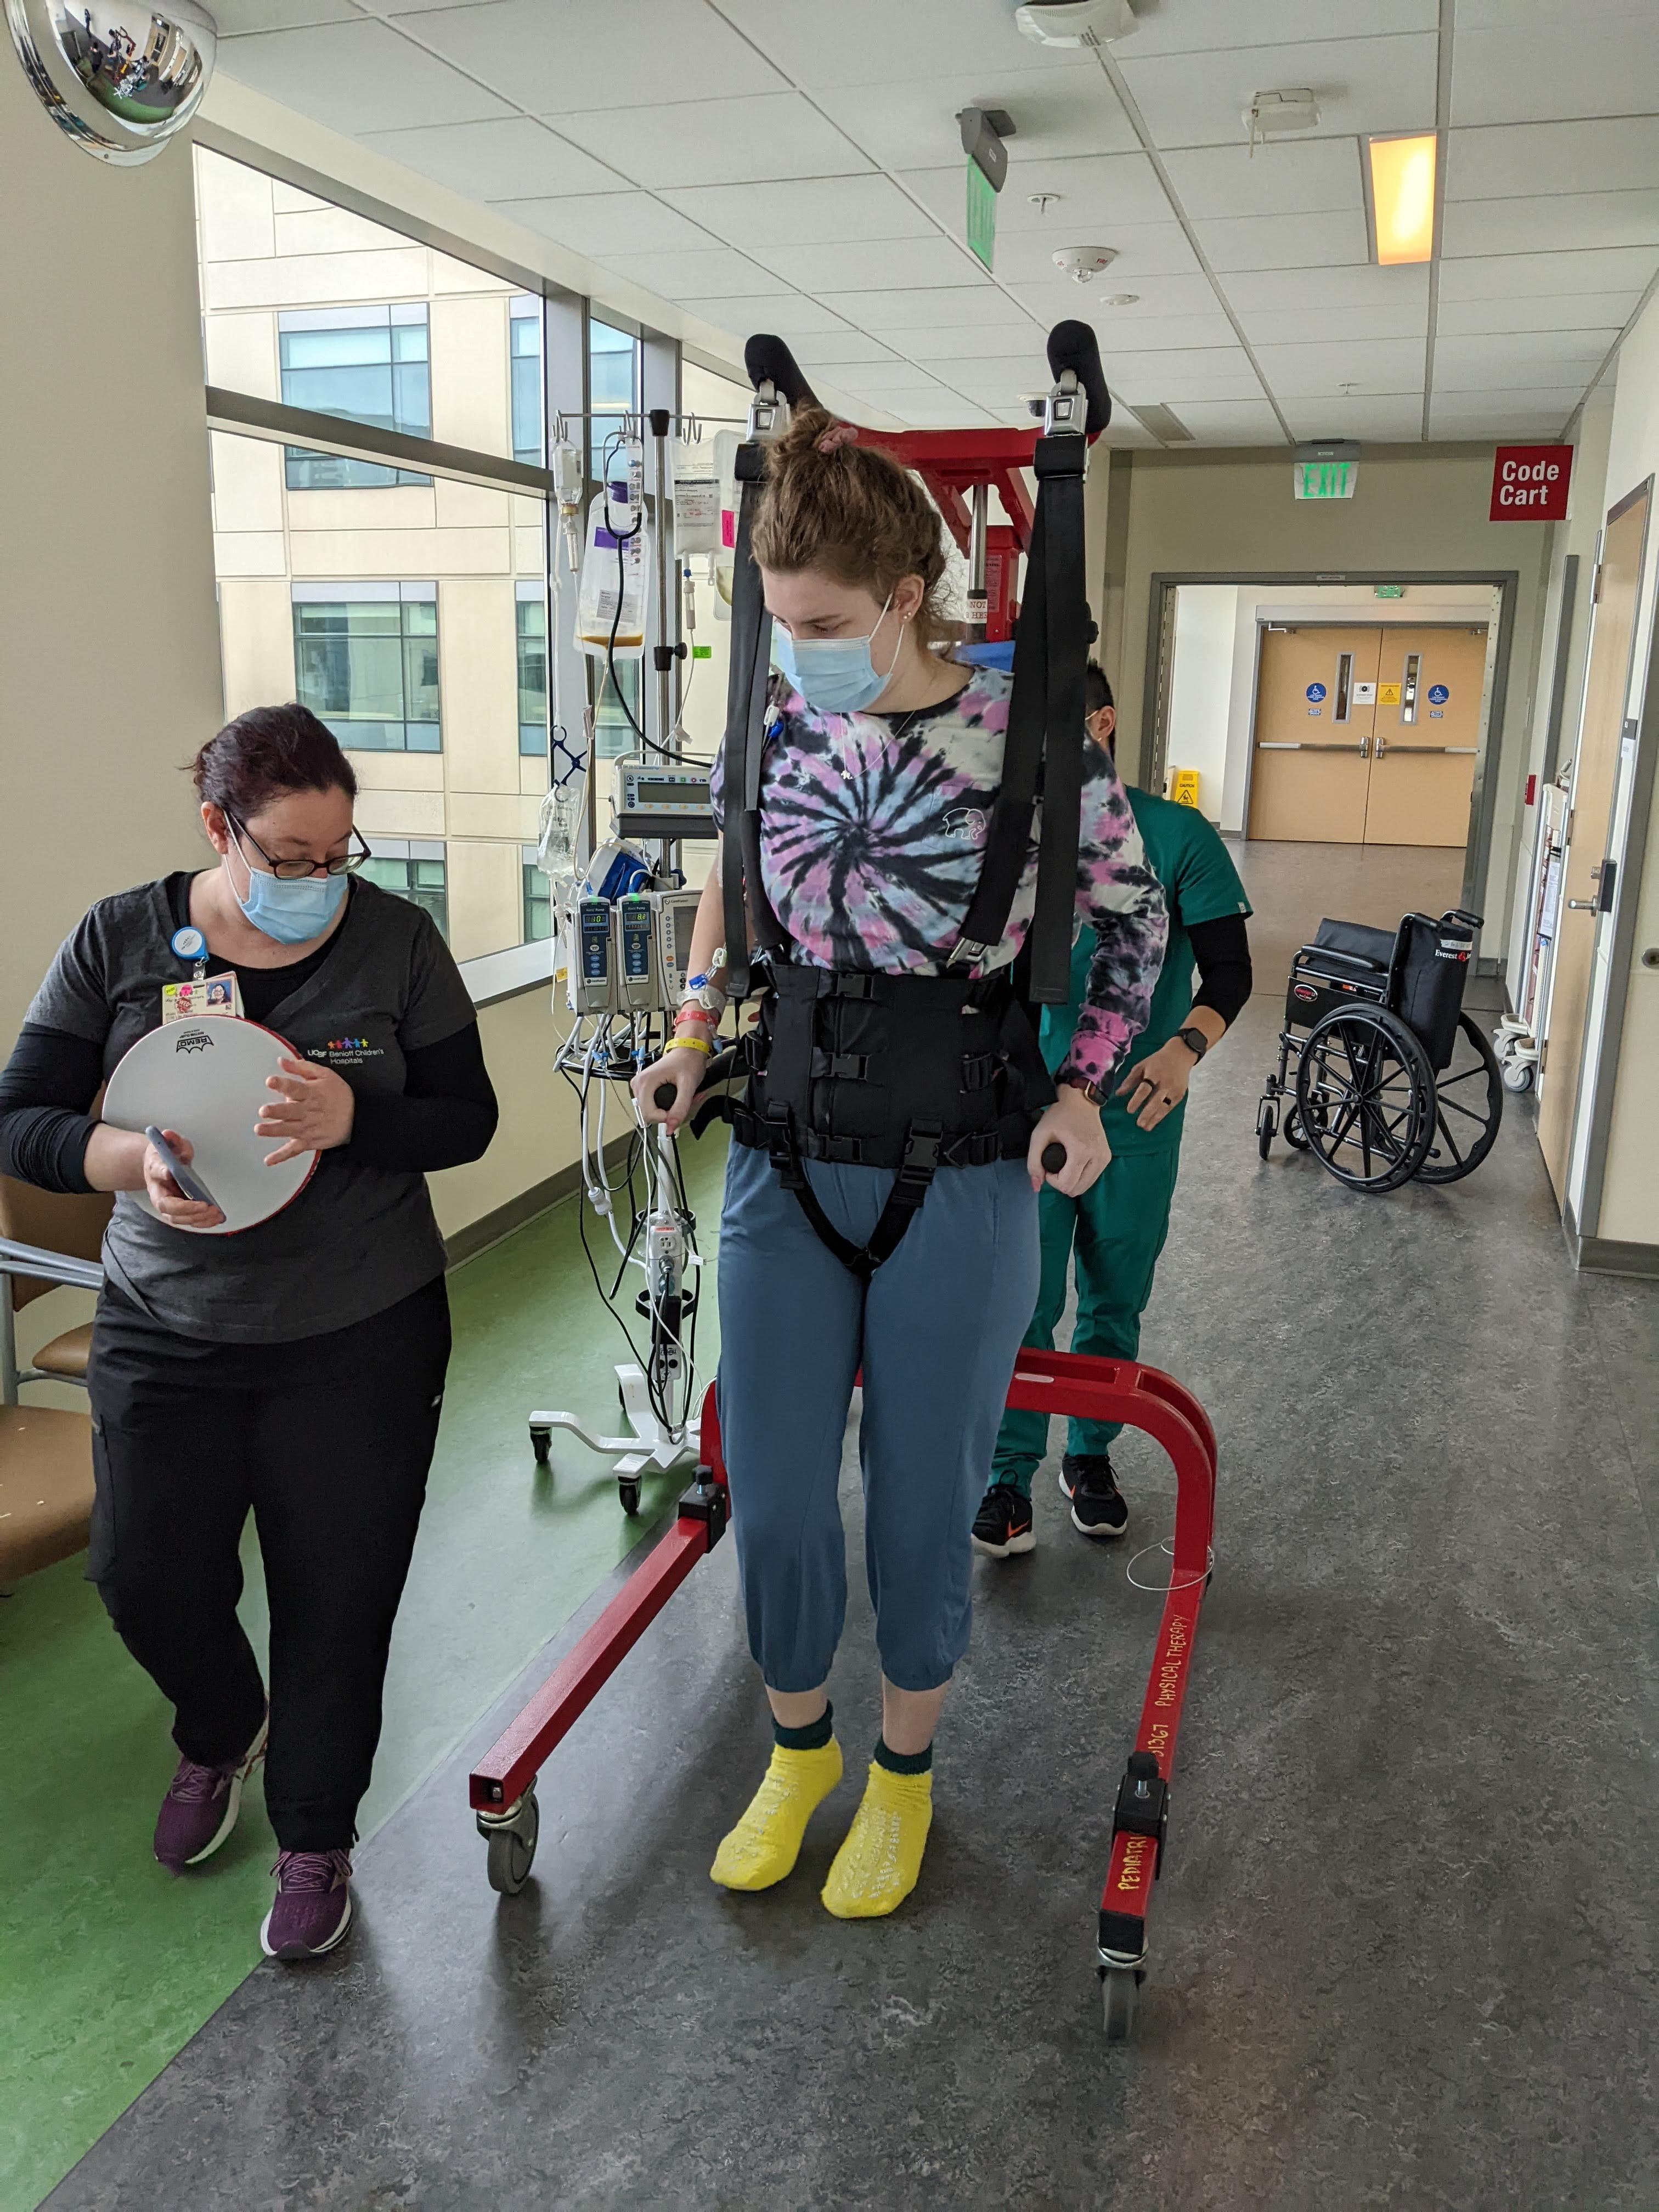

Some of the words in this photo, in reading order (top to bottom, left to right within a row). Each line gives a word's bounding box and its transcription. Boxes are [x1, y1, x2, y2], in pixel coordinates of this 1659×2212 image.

[1303, 462, 1351, 497] EXIT
[1502, 461, 1559, 481] Code
[1500, 485, 1548, 505] Cart
[1435, 949, 1457, 960] Everest
[180, 1037, 207, 1046] REMO
[355, 1048, 384, 1057] Children's
[1166, 1615, 1190, 1657] THERAPY
[1154, 1662, 1182, 1706] PHYSICAL
